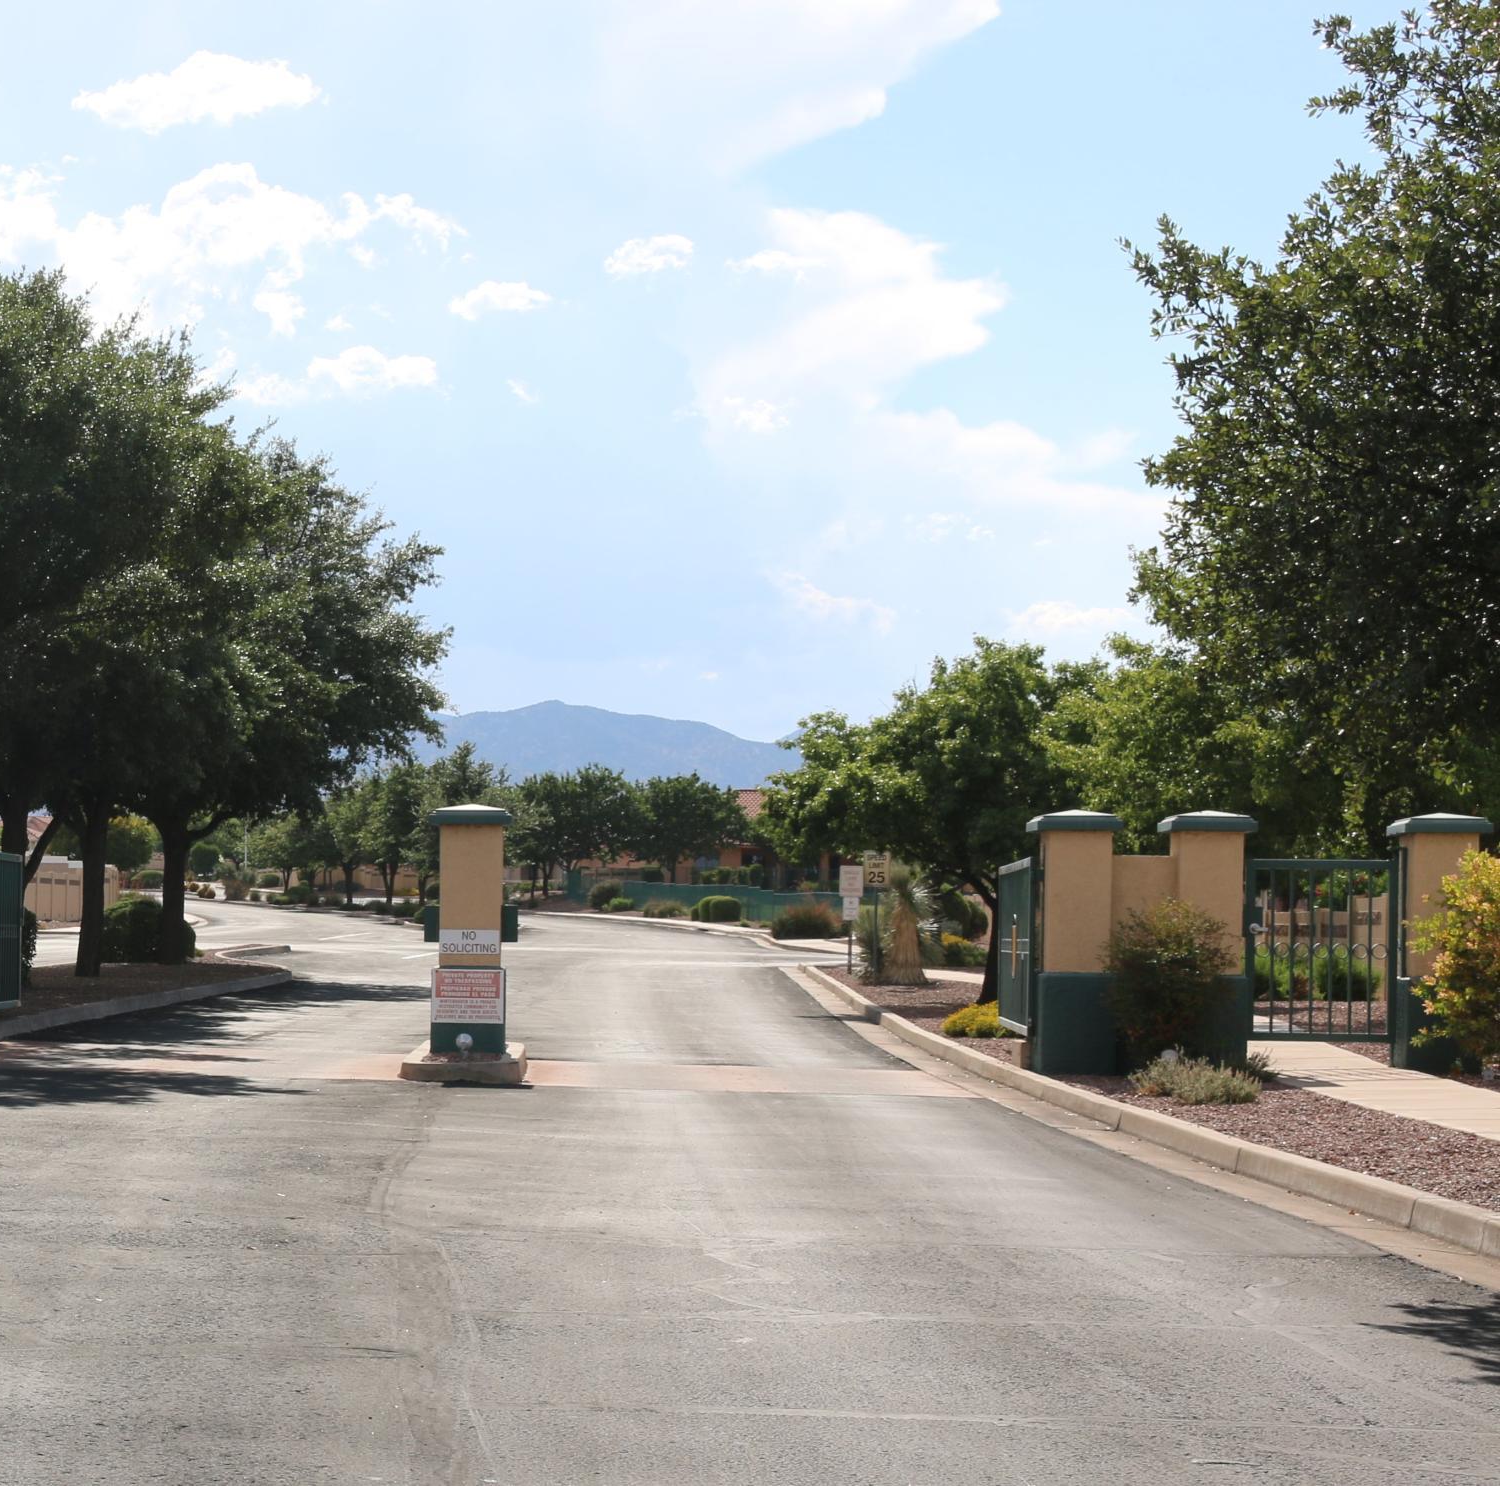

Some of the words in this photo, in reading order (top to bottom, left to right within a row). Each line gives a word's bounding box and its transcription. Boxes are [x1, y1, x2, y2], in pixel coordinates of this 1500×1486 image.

[868, 871, 885, 884] 25
[462, 931, 476, 940] NO
[442, 943, 496, 952] SOLICITING
